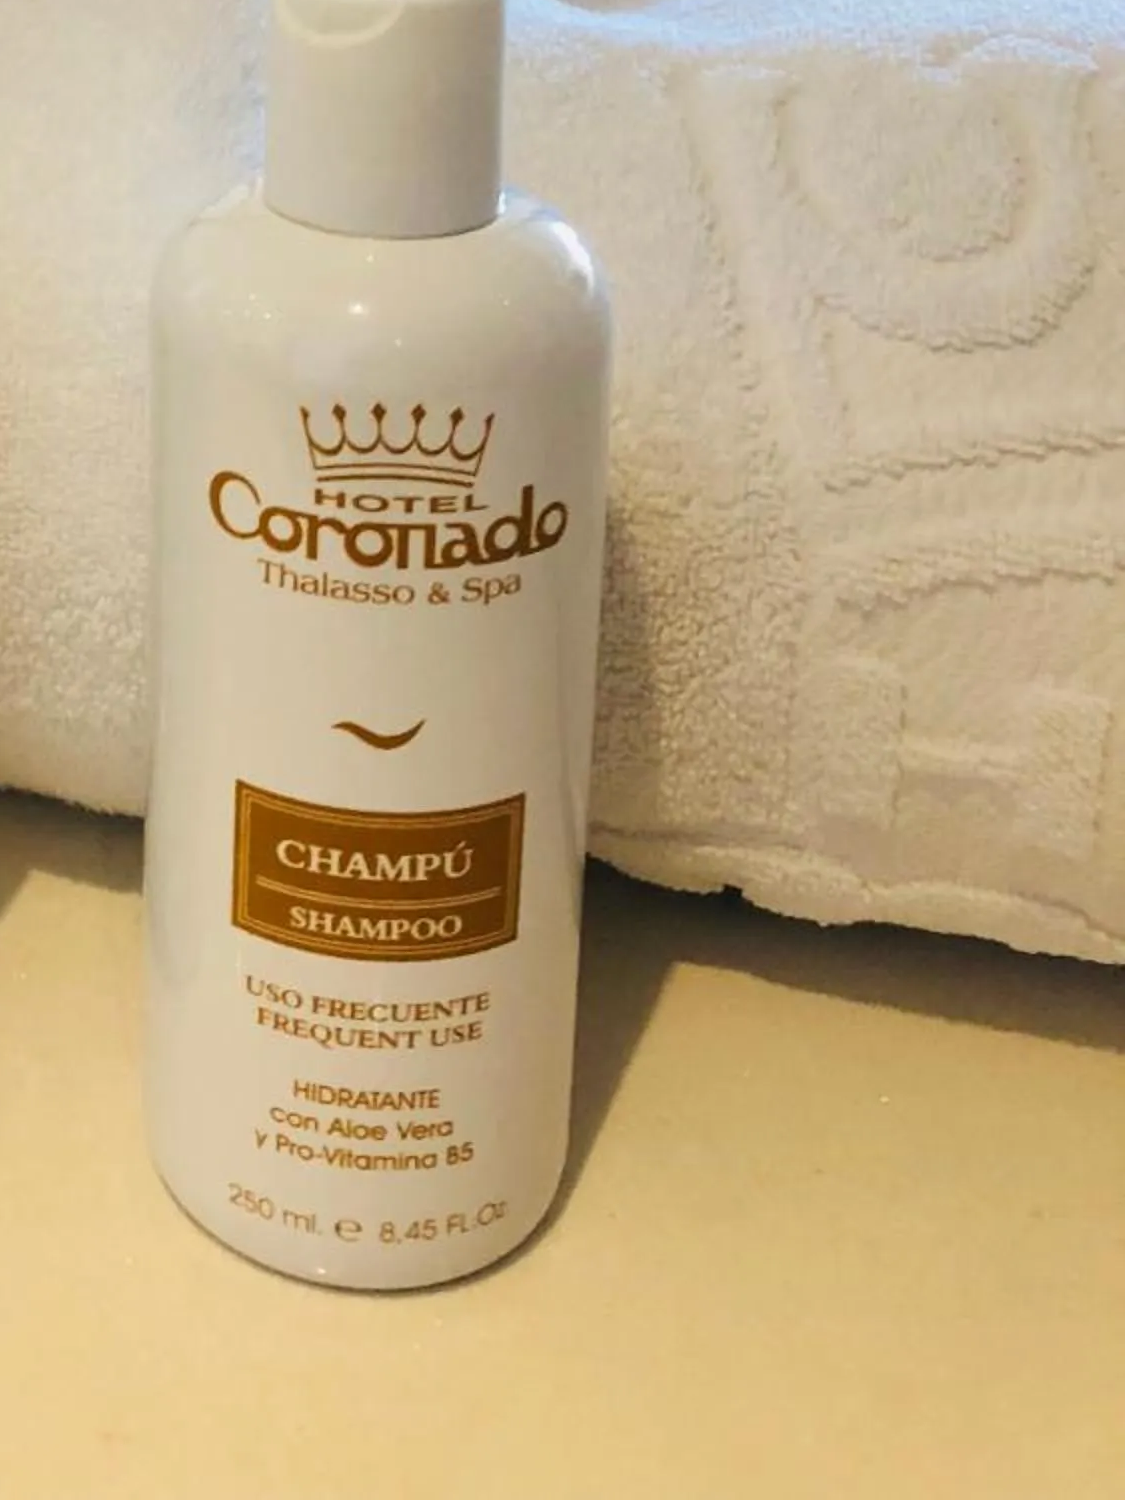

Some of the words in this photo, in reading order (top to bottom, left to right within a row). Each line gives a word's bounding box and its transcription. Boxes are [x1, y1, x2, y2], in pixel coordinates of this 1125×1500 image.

[209, 470, 568, 569] Coronado
[314, 489, 489, 514] HOTEL
[257, 558, 415, 606] Thalasso
[427, 582, 450, 606] &
[462, 573, 522, 606] Spa
[276, 839, 473, 882] CHAMPÚ
[289, 906, 462, 940] SHAMPOO
[245, 975, 303, 1009] USO
[311, 992, 490, 1023] FRECUENTE
[256, 1006, 422, 1049] FREQUENT
[430, 1021, 483, 1047] USE
[292, 1079, 440, 1110] HIDRATANTE
[270, 1107, 319, 1132] con
[327, 1118, 387, 1141] Aloe
[396, 1120, 454, 1141] Vera
[276, 1134, 437, 1170] Pro-Vitamina
[228, 1183, 274, 1220] 250
